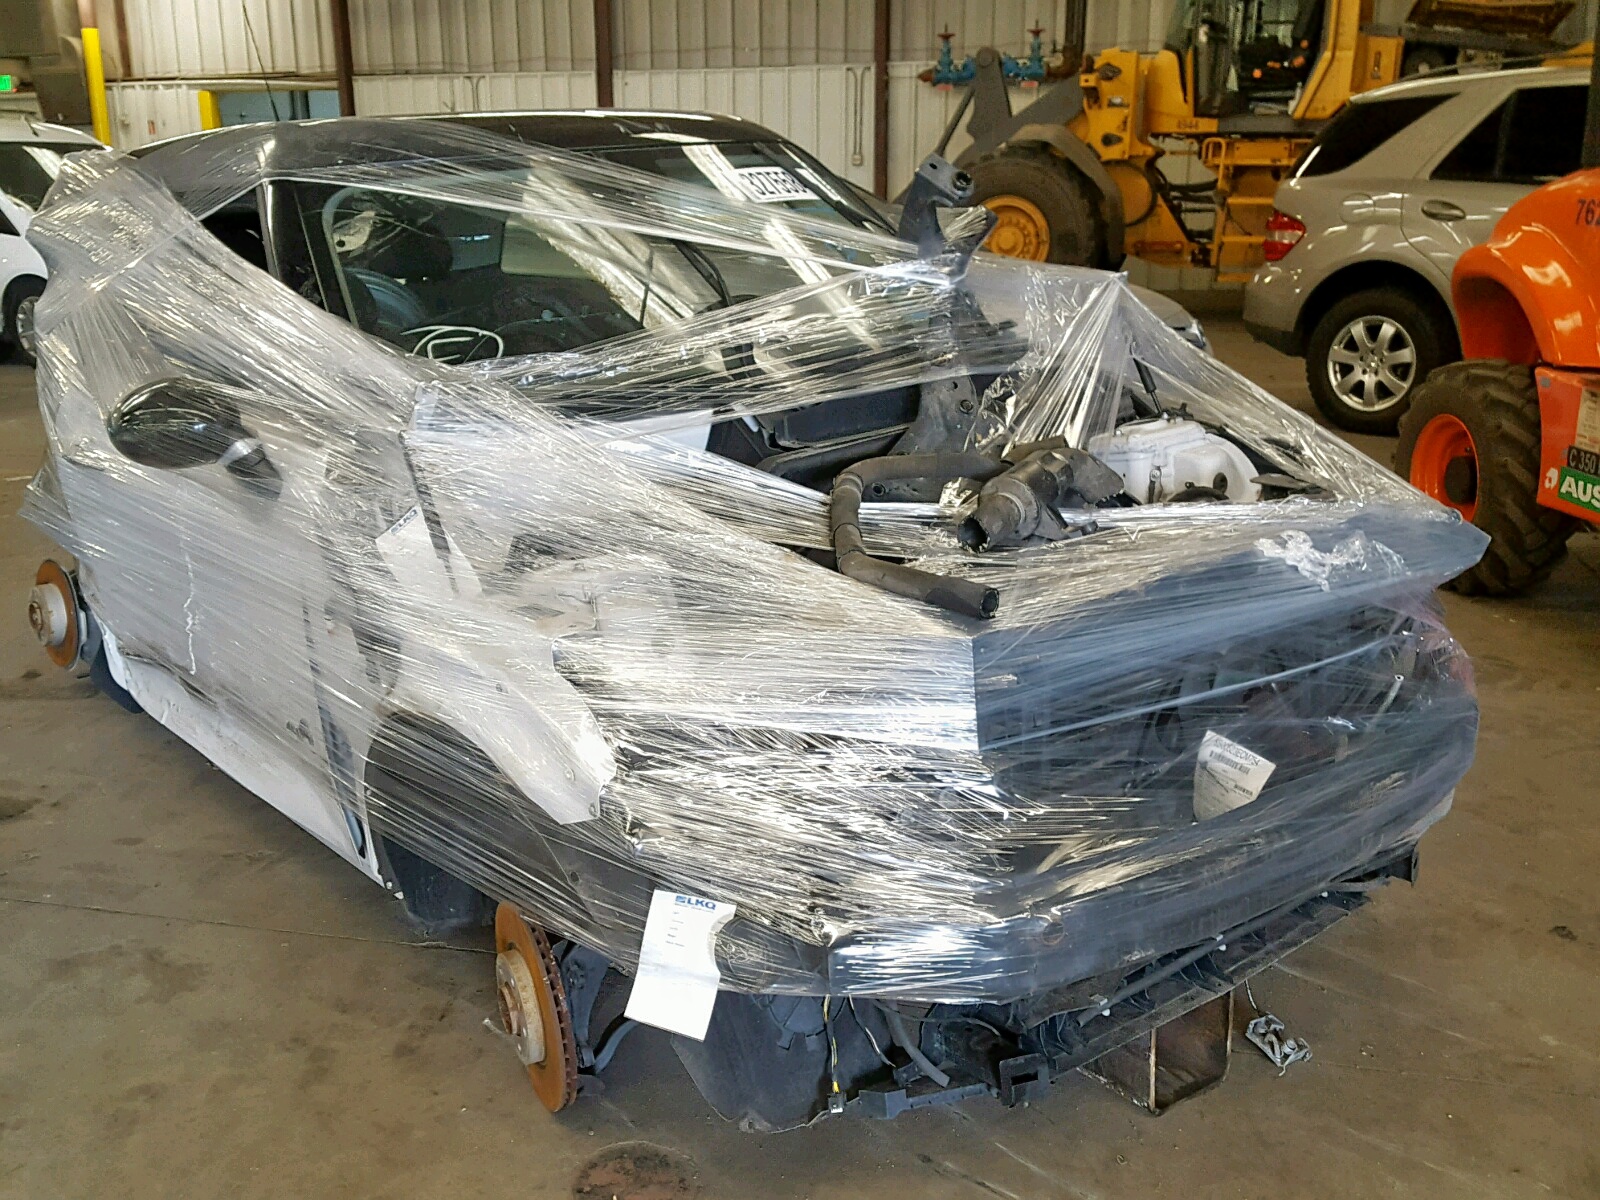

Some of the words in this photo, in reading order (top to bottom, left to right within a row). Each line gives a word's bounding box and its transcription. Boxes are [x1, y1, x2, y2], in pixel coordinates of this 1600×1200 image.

[1569, 448, 1577, 467] C
[1578, 451, 1597, 474] 350
[687, 897, 716, 910] LKQ
